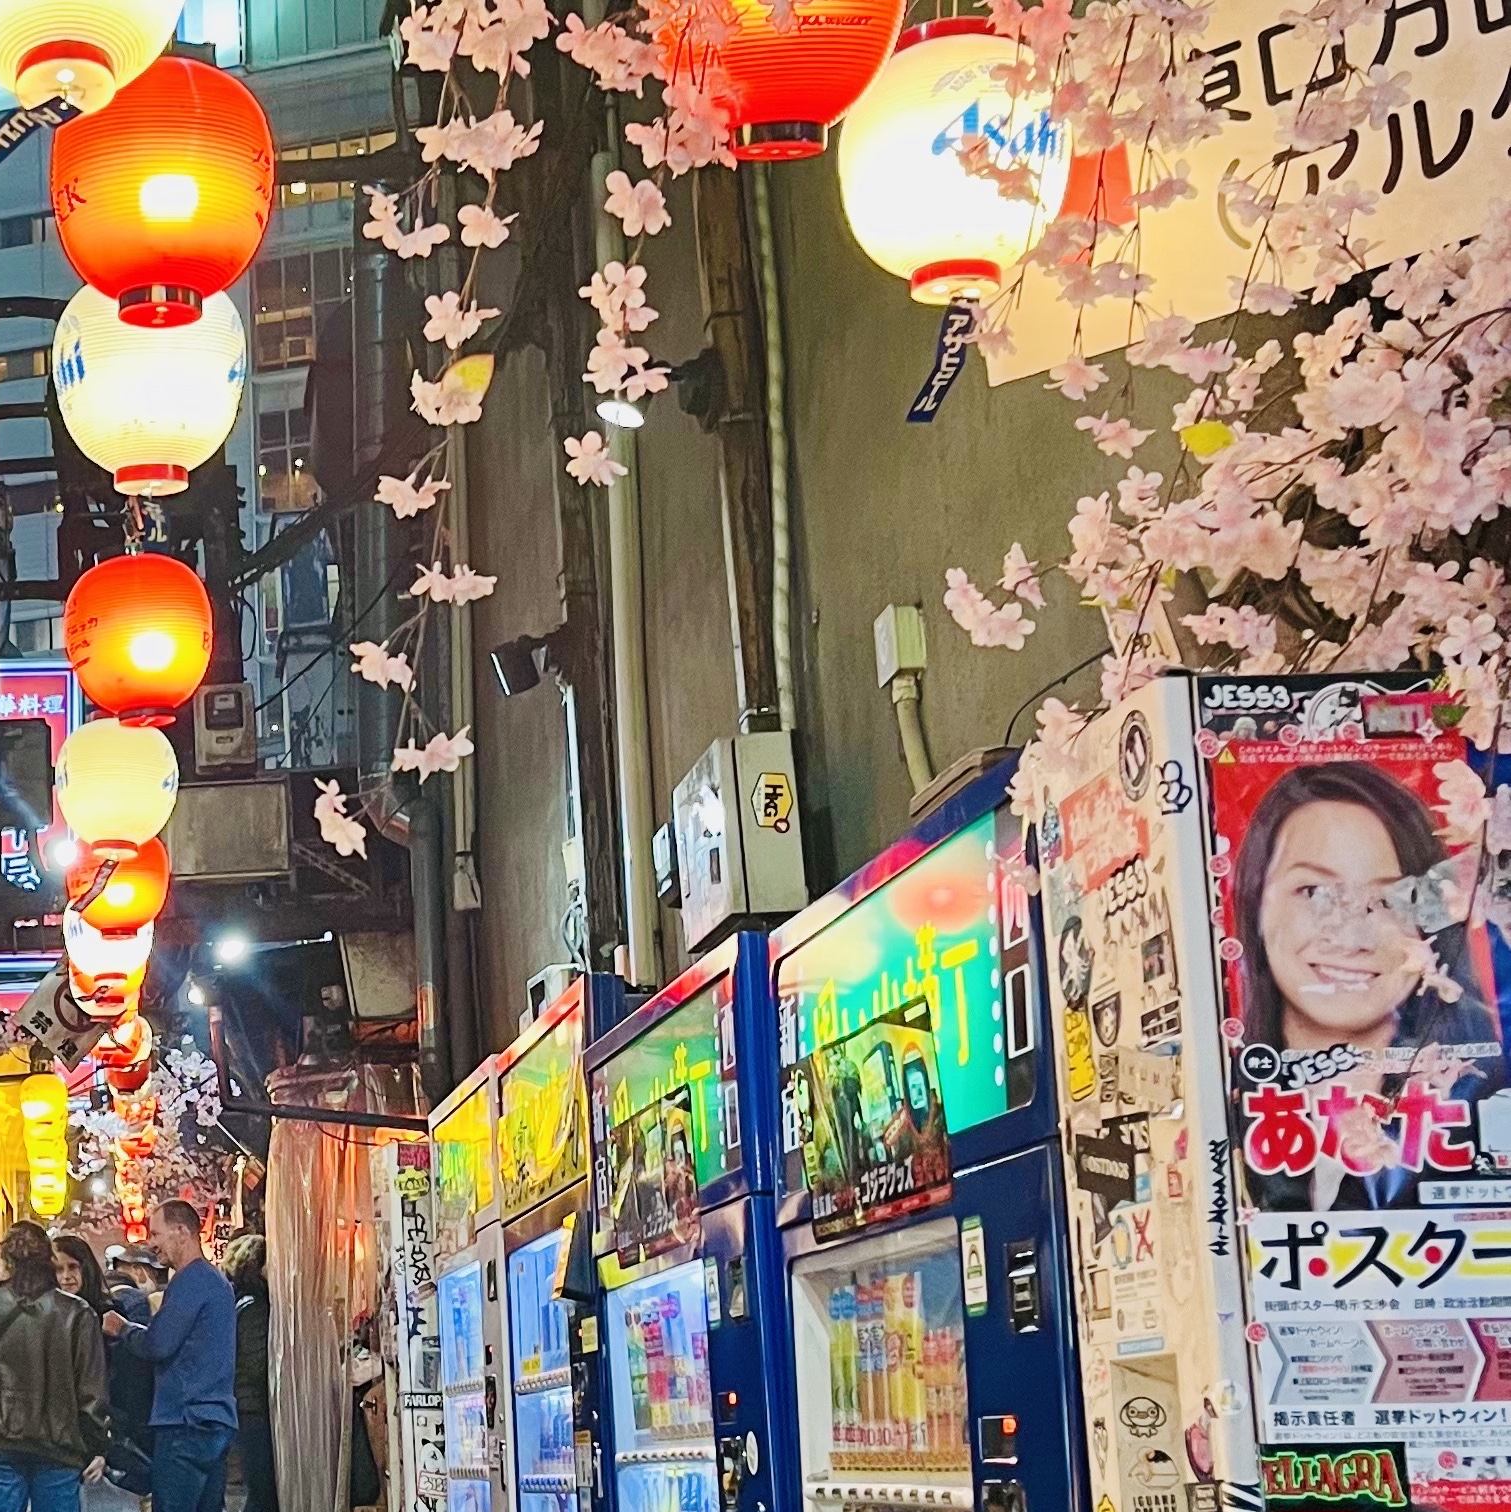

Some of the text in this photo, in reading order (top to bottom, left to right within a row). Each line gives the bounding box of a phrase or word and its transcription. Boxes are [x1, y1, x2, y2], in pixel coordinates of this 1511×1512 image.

[1204, 684, 1290, 709] JESS3
[1259, 1219, 1511, 1290] ポスター
